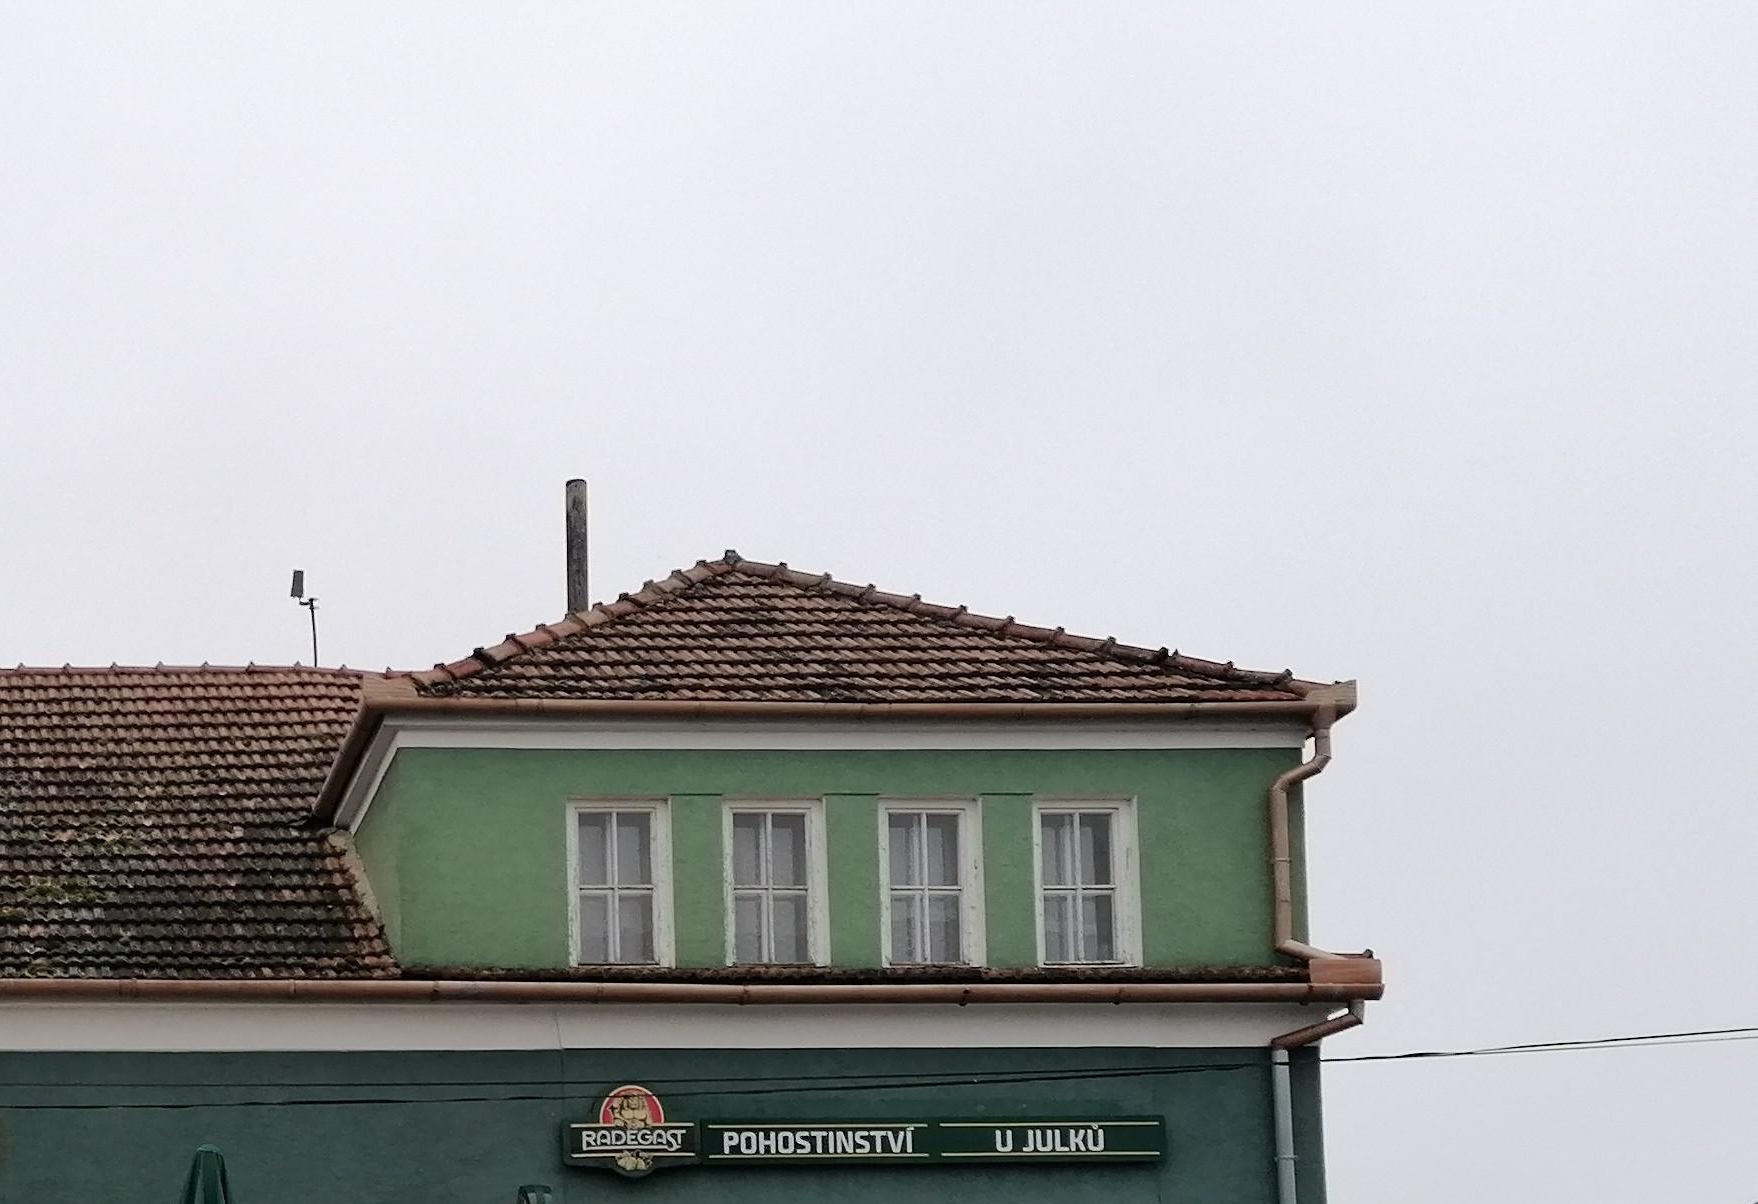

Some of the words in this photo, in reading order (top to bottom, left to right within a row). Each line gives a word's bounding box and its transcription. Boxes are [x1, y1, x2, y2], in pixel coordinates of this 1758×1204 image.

[582, 1129, 686, 1151] RADEGAST
[723, 1126, 913, 1154] POHOSTINSTVÍ
[995, 1129, 1013, 1152] U
[1022, 1123, 1105, 1152] JULKŮ
